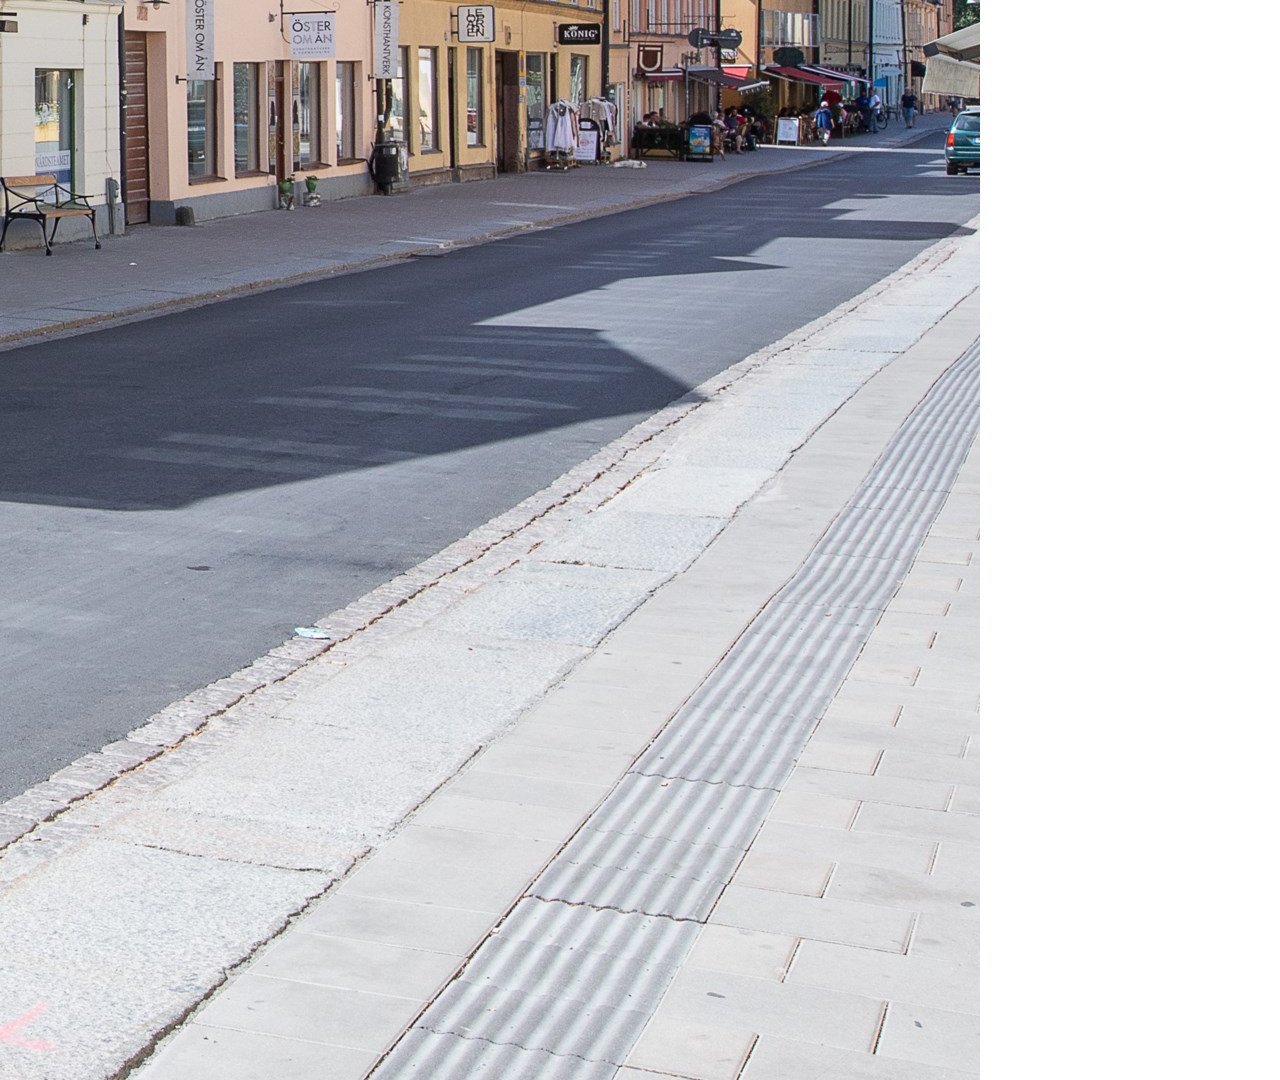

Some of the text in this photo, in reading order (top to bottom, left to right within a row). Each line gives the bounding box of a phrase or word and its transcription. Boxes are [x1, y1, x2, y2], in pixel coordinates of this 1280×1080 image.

[195, 0, 208, 71] ÖSTER OM ÅN
[292, 20, 331, 32] ÖSTER
[293, 32, 332, 44] OM ÅN
[383, 5, 392, 74] KONSTHANTVERK
